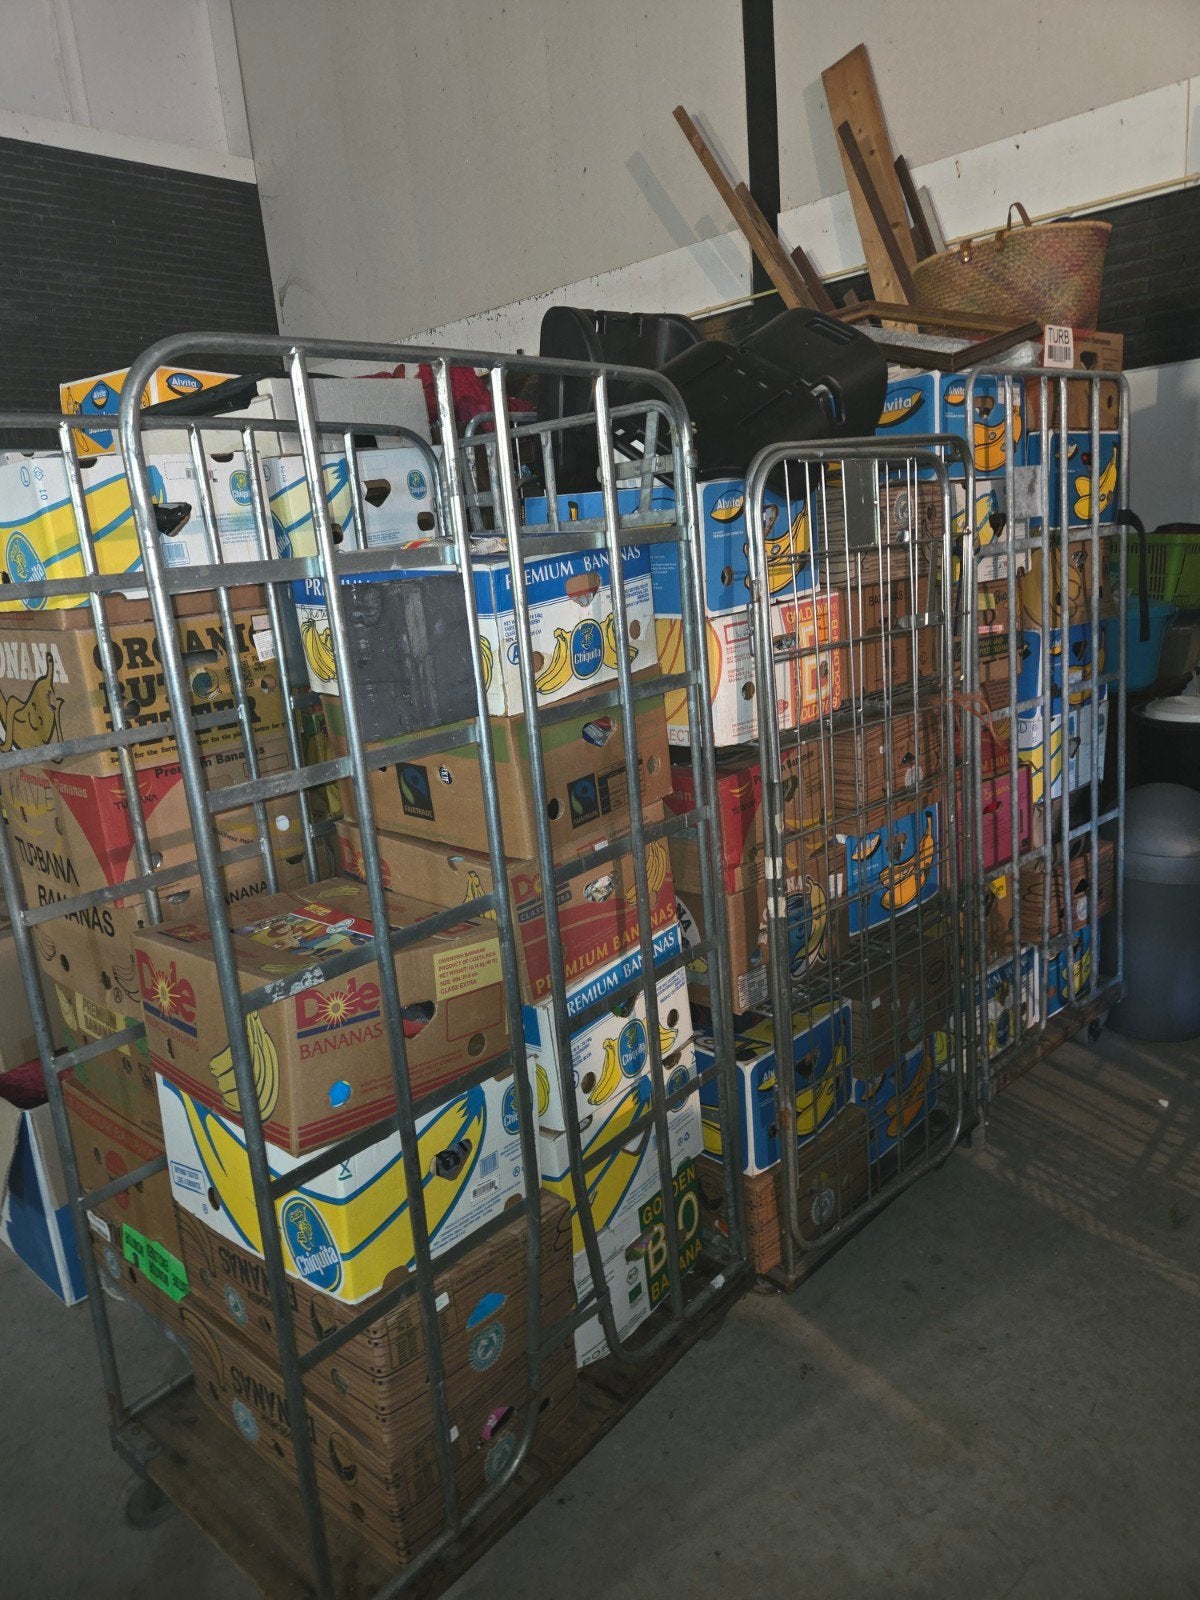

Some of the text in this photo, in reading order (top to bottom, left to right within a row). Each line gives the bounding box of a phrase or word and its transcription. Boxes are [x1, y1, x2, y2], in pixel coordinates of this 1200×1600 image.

[1048, 328, 1070, 344] TURB
[171, 377, 197, 388] Alvita
[883, 397, 912, 413] lvita
[505, 544, 641, 590] PEMIUM BANNAS
[0, 641, 69, 683] NANA
[93, 623, 254, 673] ORANI
[574, 648, 601, 665] Chiquita
[155, 746, 266, 779] Prem Banas
[20, 769, 88, 799] Premium Bananas
[404, 805, 433, 818] FAIRTRADE
[224, 881, 268, 905] NANA
[536, 944, 609, 995] PMIUM
[614, 904, 675, 950] BANNAS
[135, 949, 197, 1023] Dole
[567, 971, 619, 1018] REMIUM
[623, 932, 675, 978] BANNAS
[295, 977, 380, 1030] Dole
[300, 1022, 384, 1061] BANANAS
[622, 1043, 646, 1066] Chiquita
[643, 1164, 695, 1225] GOEN
[648, 1191, 699, 1277] BO
[219, 1247, 298, 1313] BNANAS
[295, 1245, 341, 1277] Chiquita
[652, 1238, 703, 1301] BAANA
[231, 1366, 317, 1445] NANAS
